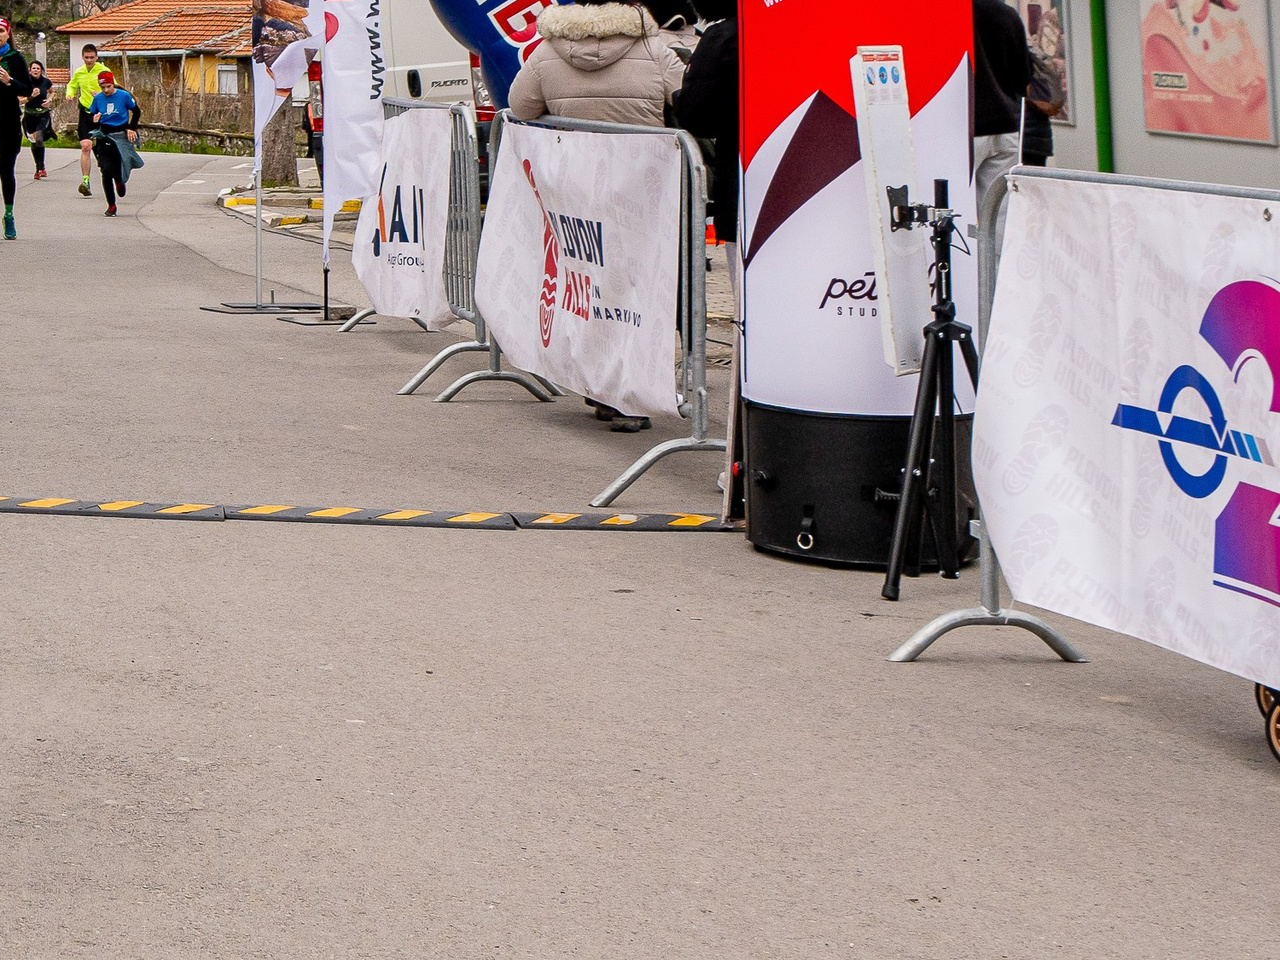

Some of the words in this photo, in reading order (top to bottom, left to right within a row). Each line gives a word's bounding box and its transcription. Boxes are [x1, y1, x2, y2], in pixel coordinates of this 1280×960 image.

[431, 78, 469, 87] DUCATO
[562, 266, 591, 321] HILLS
[591, 284, 601, 300] IN
